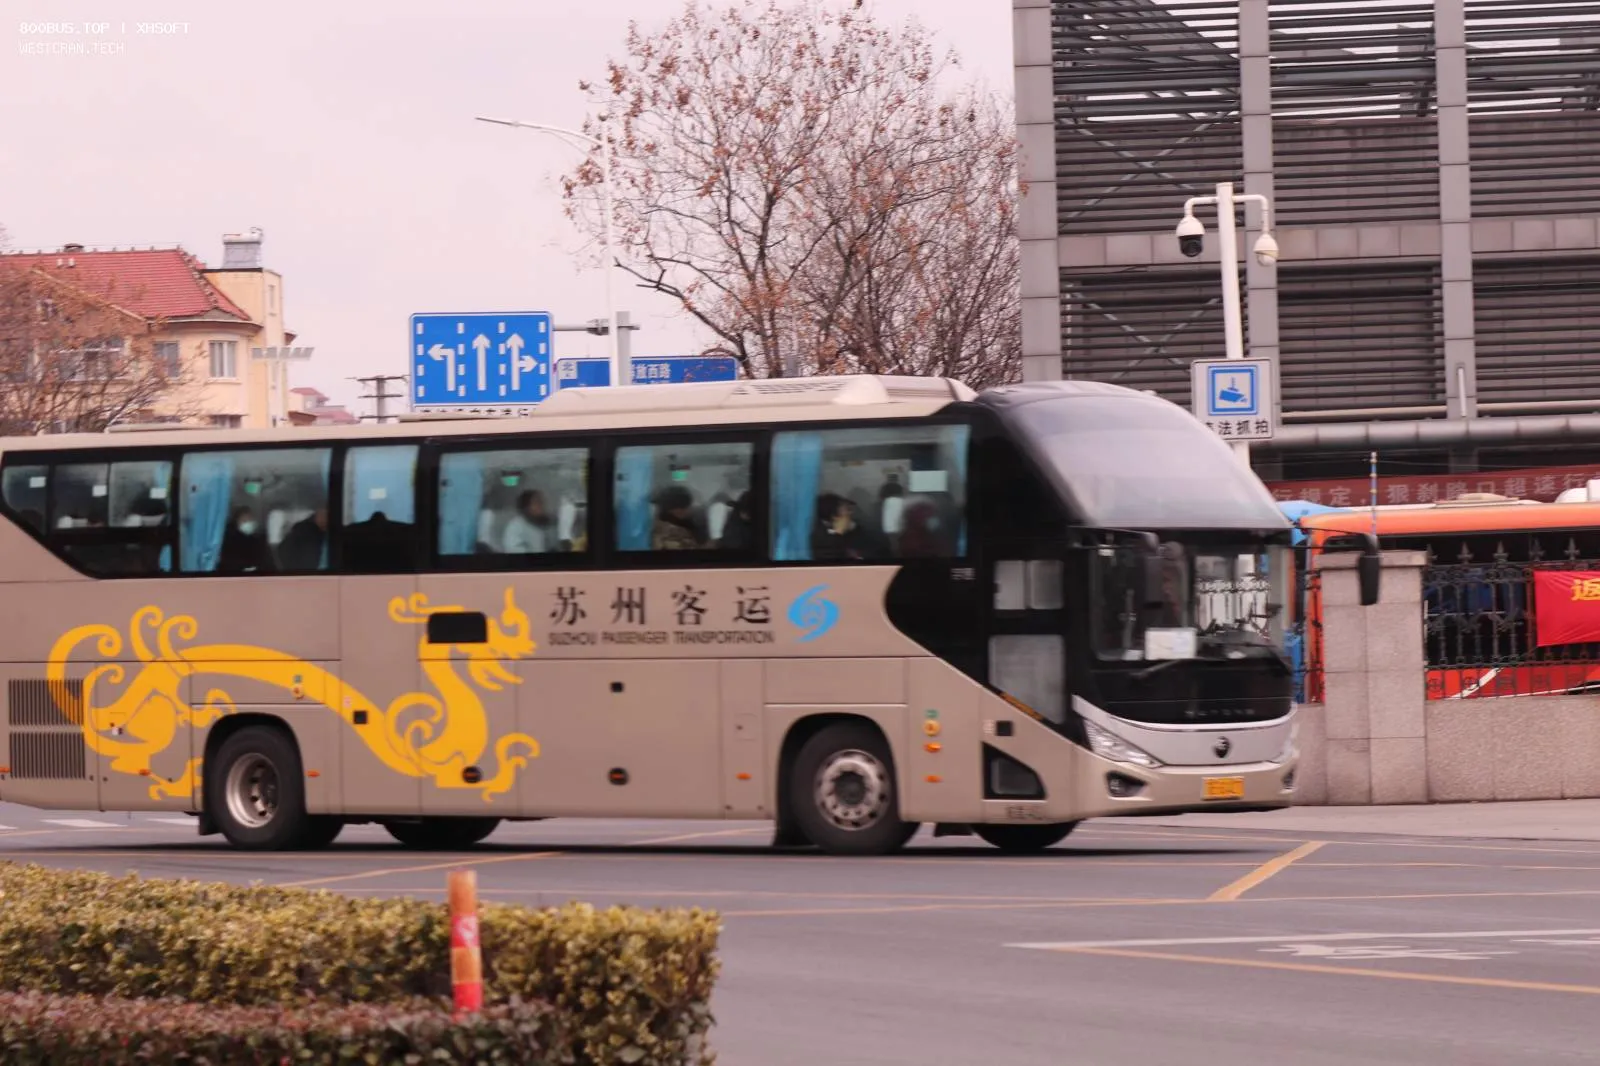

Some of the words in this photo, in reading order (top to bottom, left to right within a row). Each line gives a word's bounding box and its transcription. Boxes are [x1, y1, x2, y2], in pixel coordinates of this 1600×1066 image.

[550, 584, 771, 625] 苏州客运
[549, 632, 596, 646] SUZHOU
[602, 631, 668, 645] PASSENGER
[673, 630, 775, 644] TRANSPORTATION
